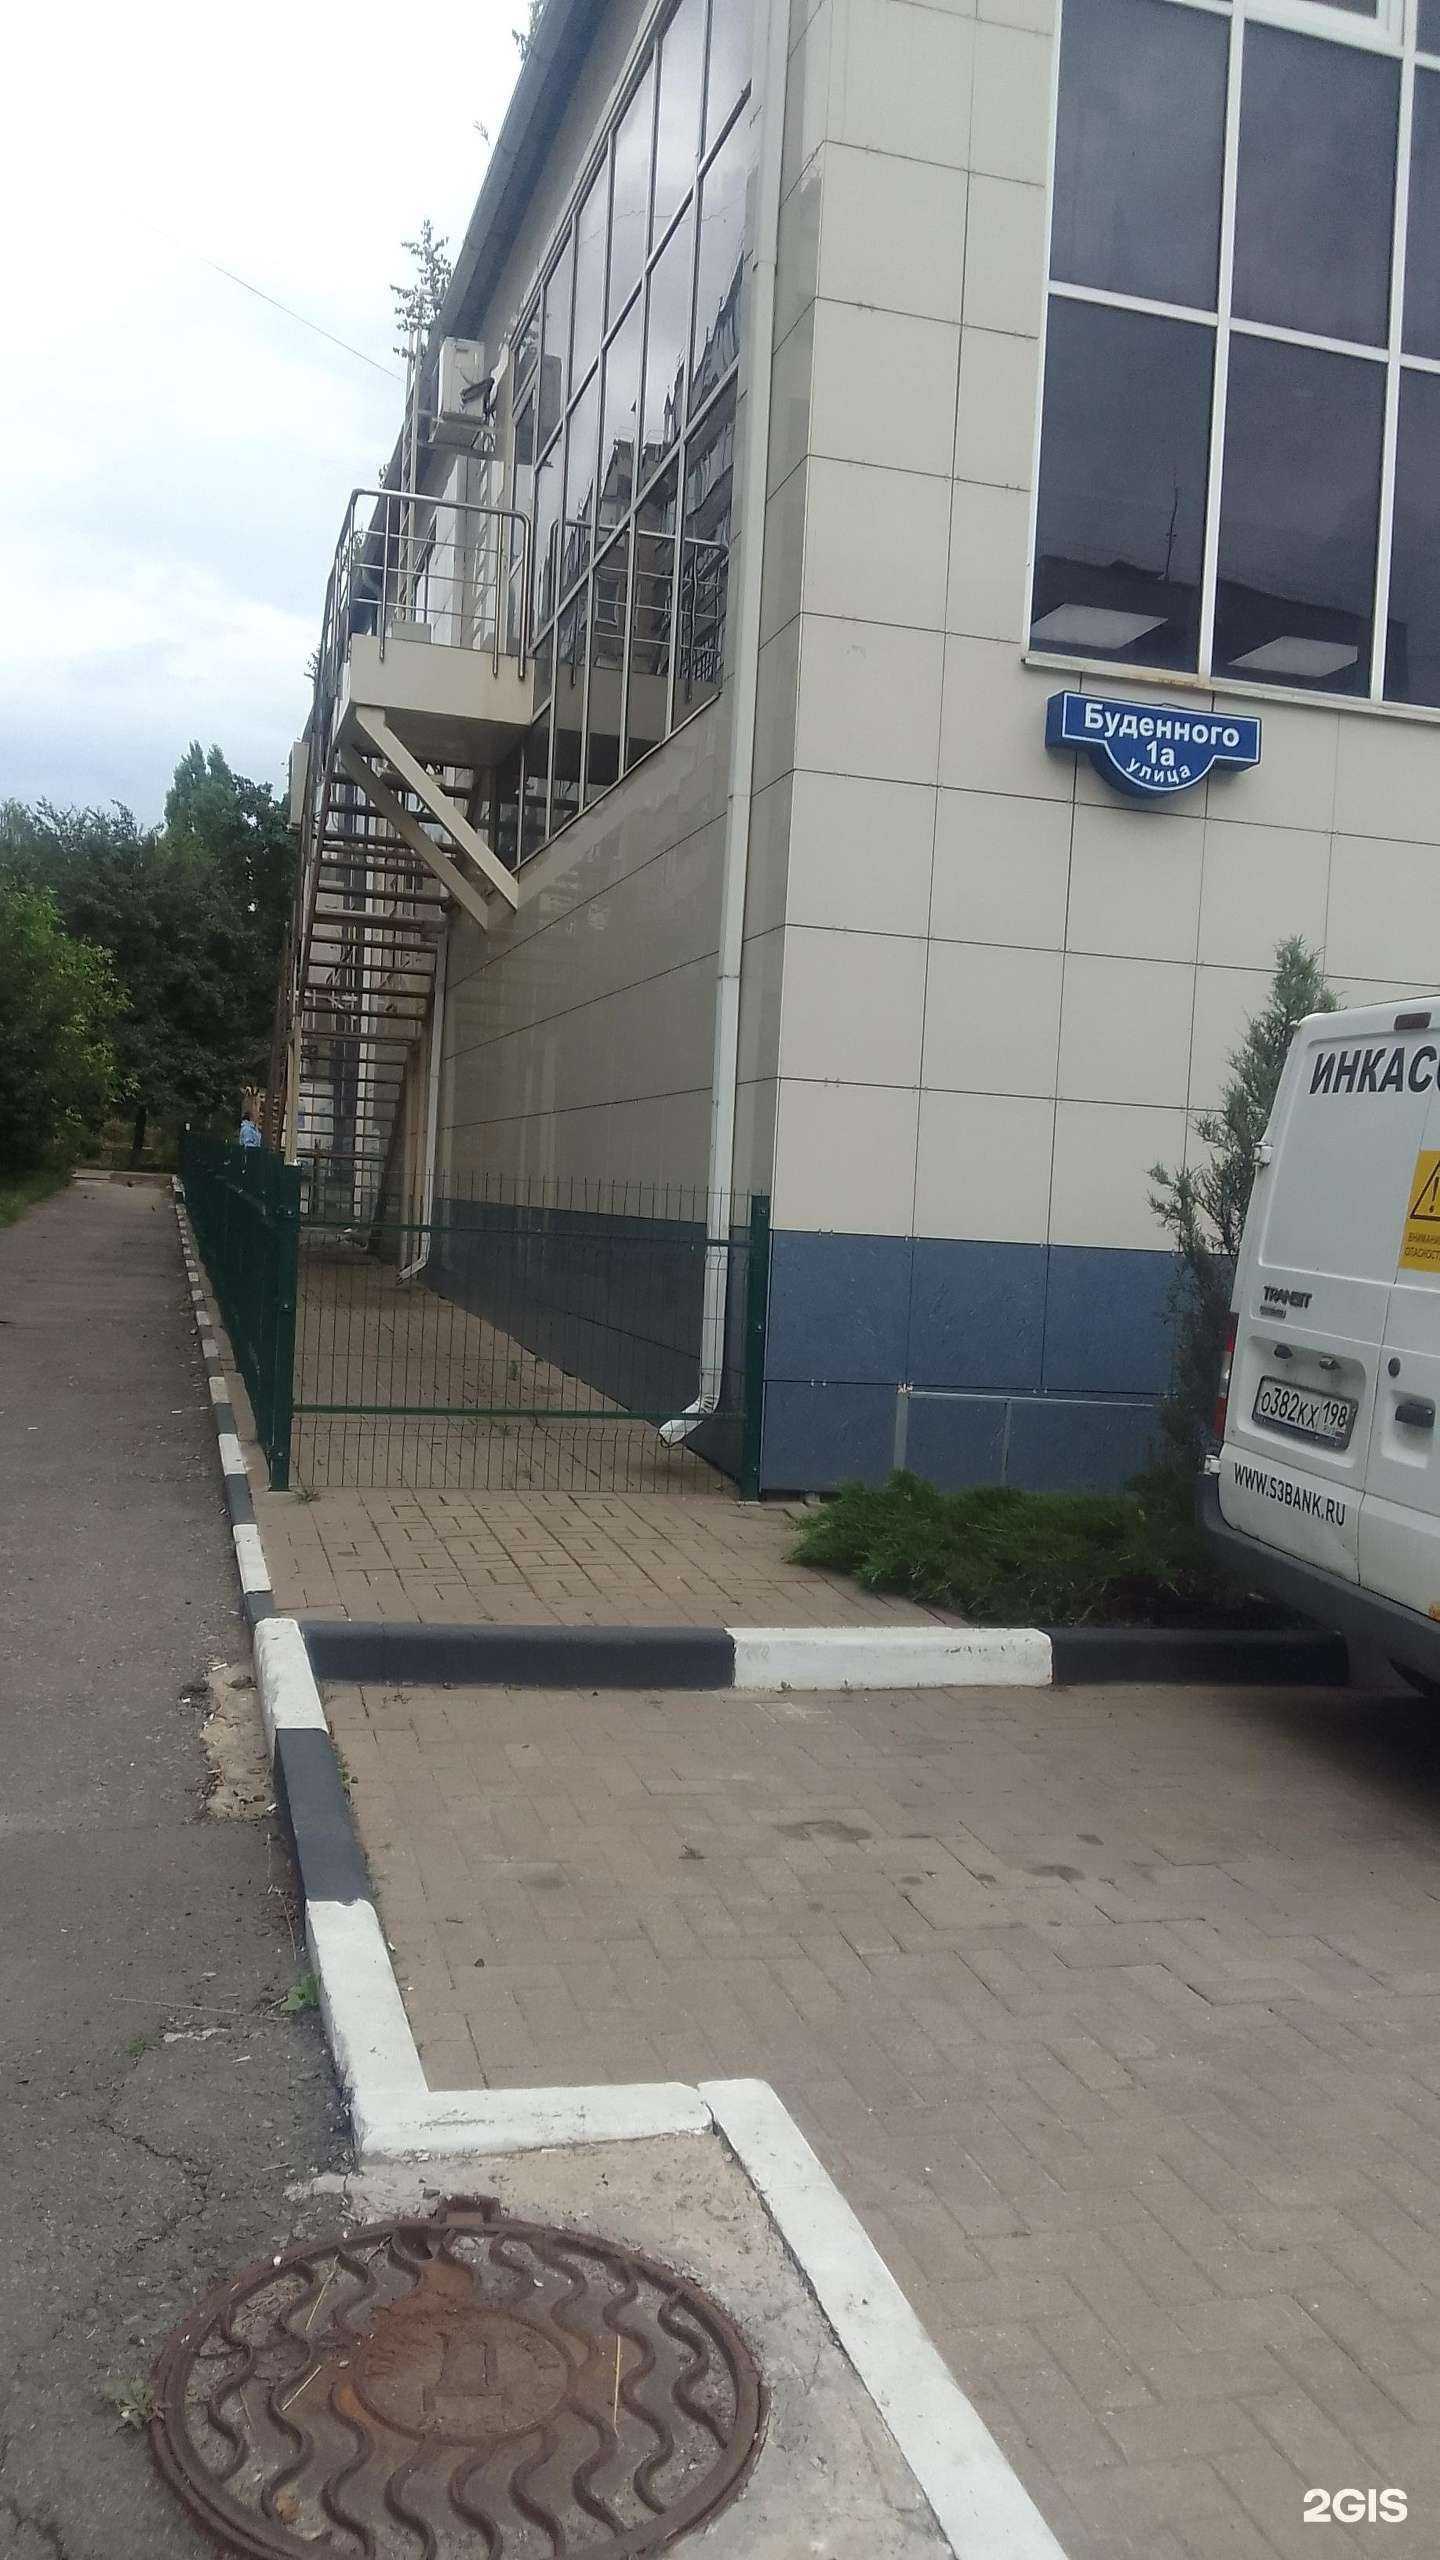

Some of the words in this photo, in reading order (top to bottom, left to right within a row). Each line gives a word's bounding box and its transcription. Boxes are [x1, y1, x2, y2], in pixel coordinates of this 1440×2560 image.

[1084, 702, 1240, 747] Буденного
[1126, 758, 1191, 784] улица
[1146, 741, 1176, 766] 1а
[1309, 1045, 1440, 1095] ИНКАС
[1234, 1462, 1346, 1526] WWW.S3BANK.RU
